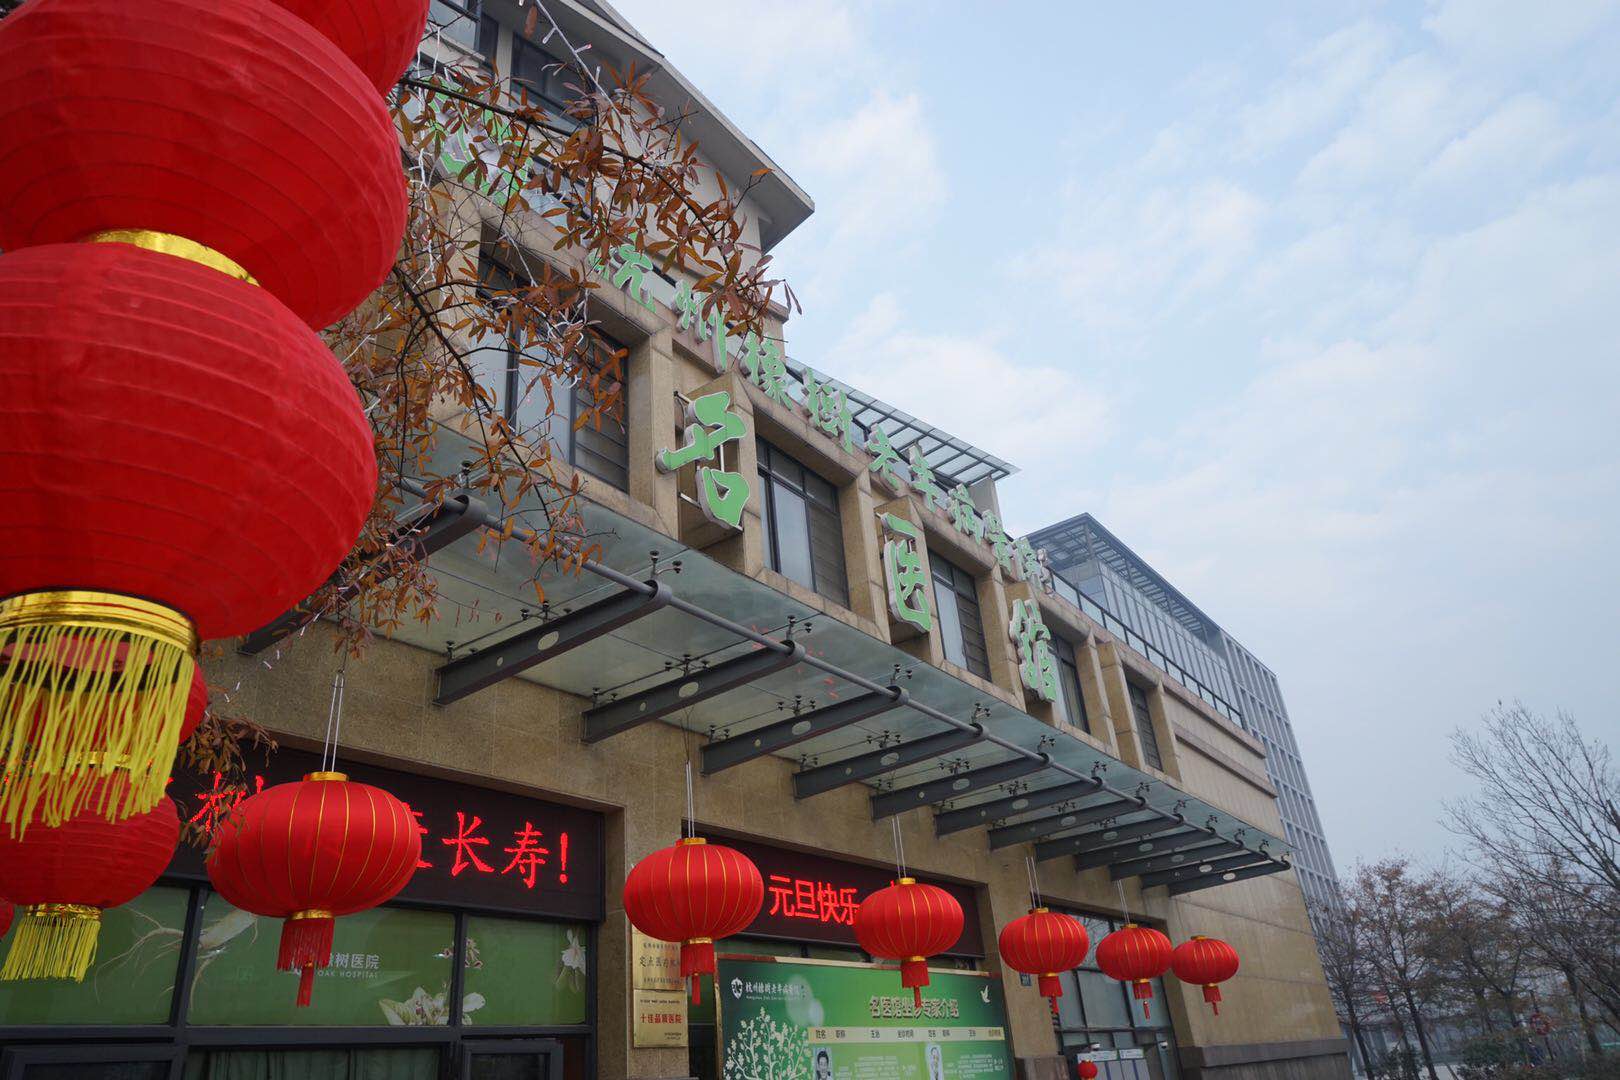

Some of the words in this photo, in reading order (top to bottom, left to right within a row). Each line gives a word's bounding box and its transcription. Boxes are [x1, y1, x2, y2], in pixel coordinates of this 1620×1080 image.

[768, 874, 860, 926] 元旦快乐
[340, 971, 378, 979] HOSPITAL
